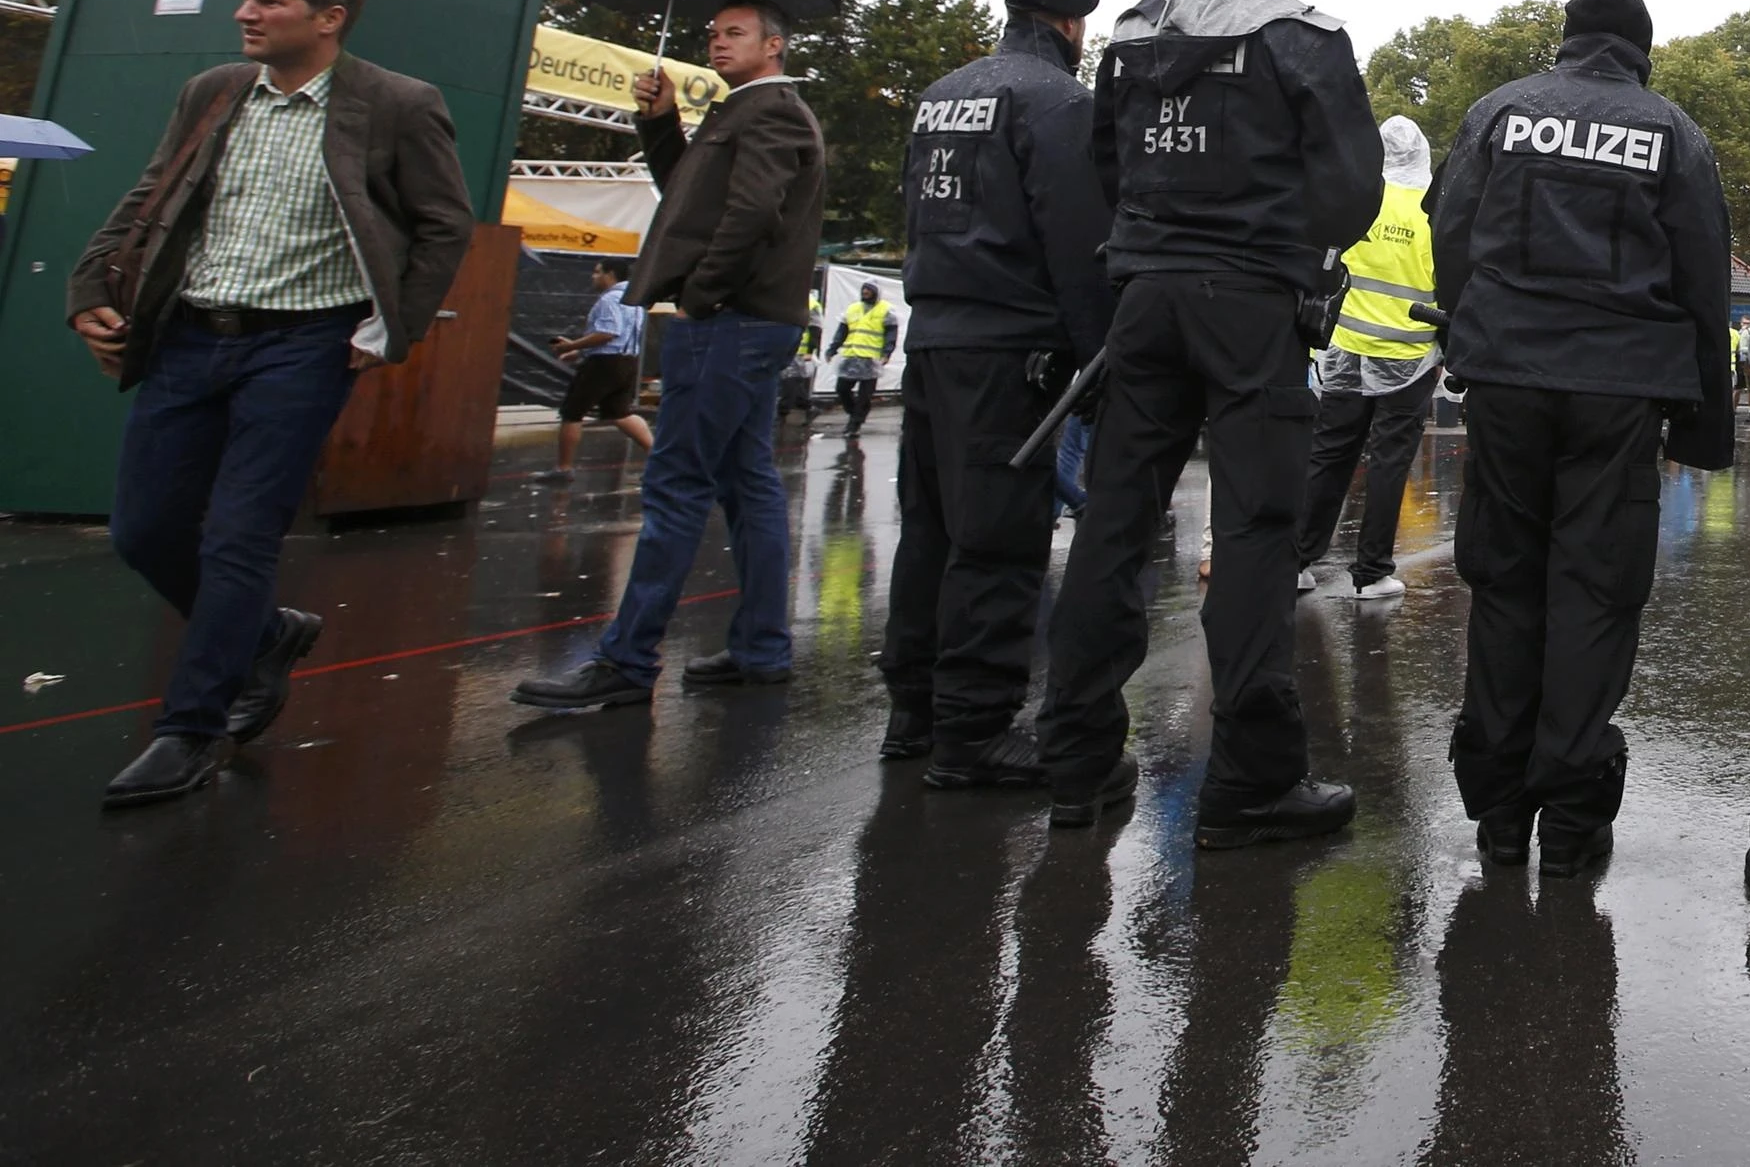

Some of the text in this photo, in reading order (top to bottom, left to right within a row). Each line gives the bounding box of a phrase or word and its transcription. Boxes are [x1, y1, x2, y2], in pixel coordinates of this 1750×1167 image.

[912, 98, 998, 133] POLIZEI
[1160, 95, 1192, 124] BY
[1144, 126, 1206, 154] 5431
[1502, 114, 1664, 172] POLIZEI
[929, 148, 955, 173] BY
[1382, 234, 1411, 246] Security
